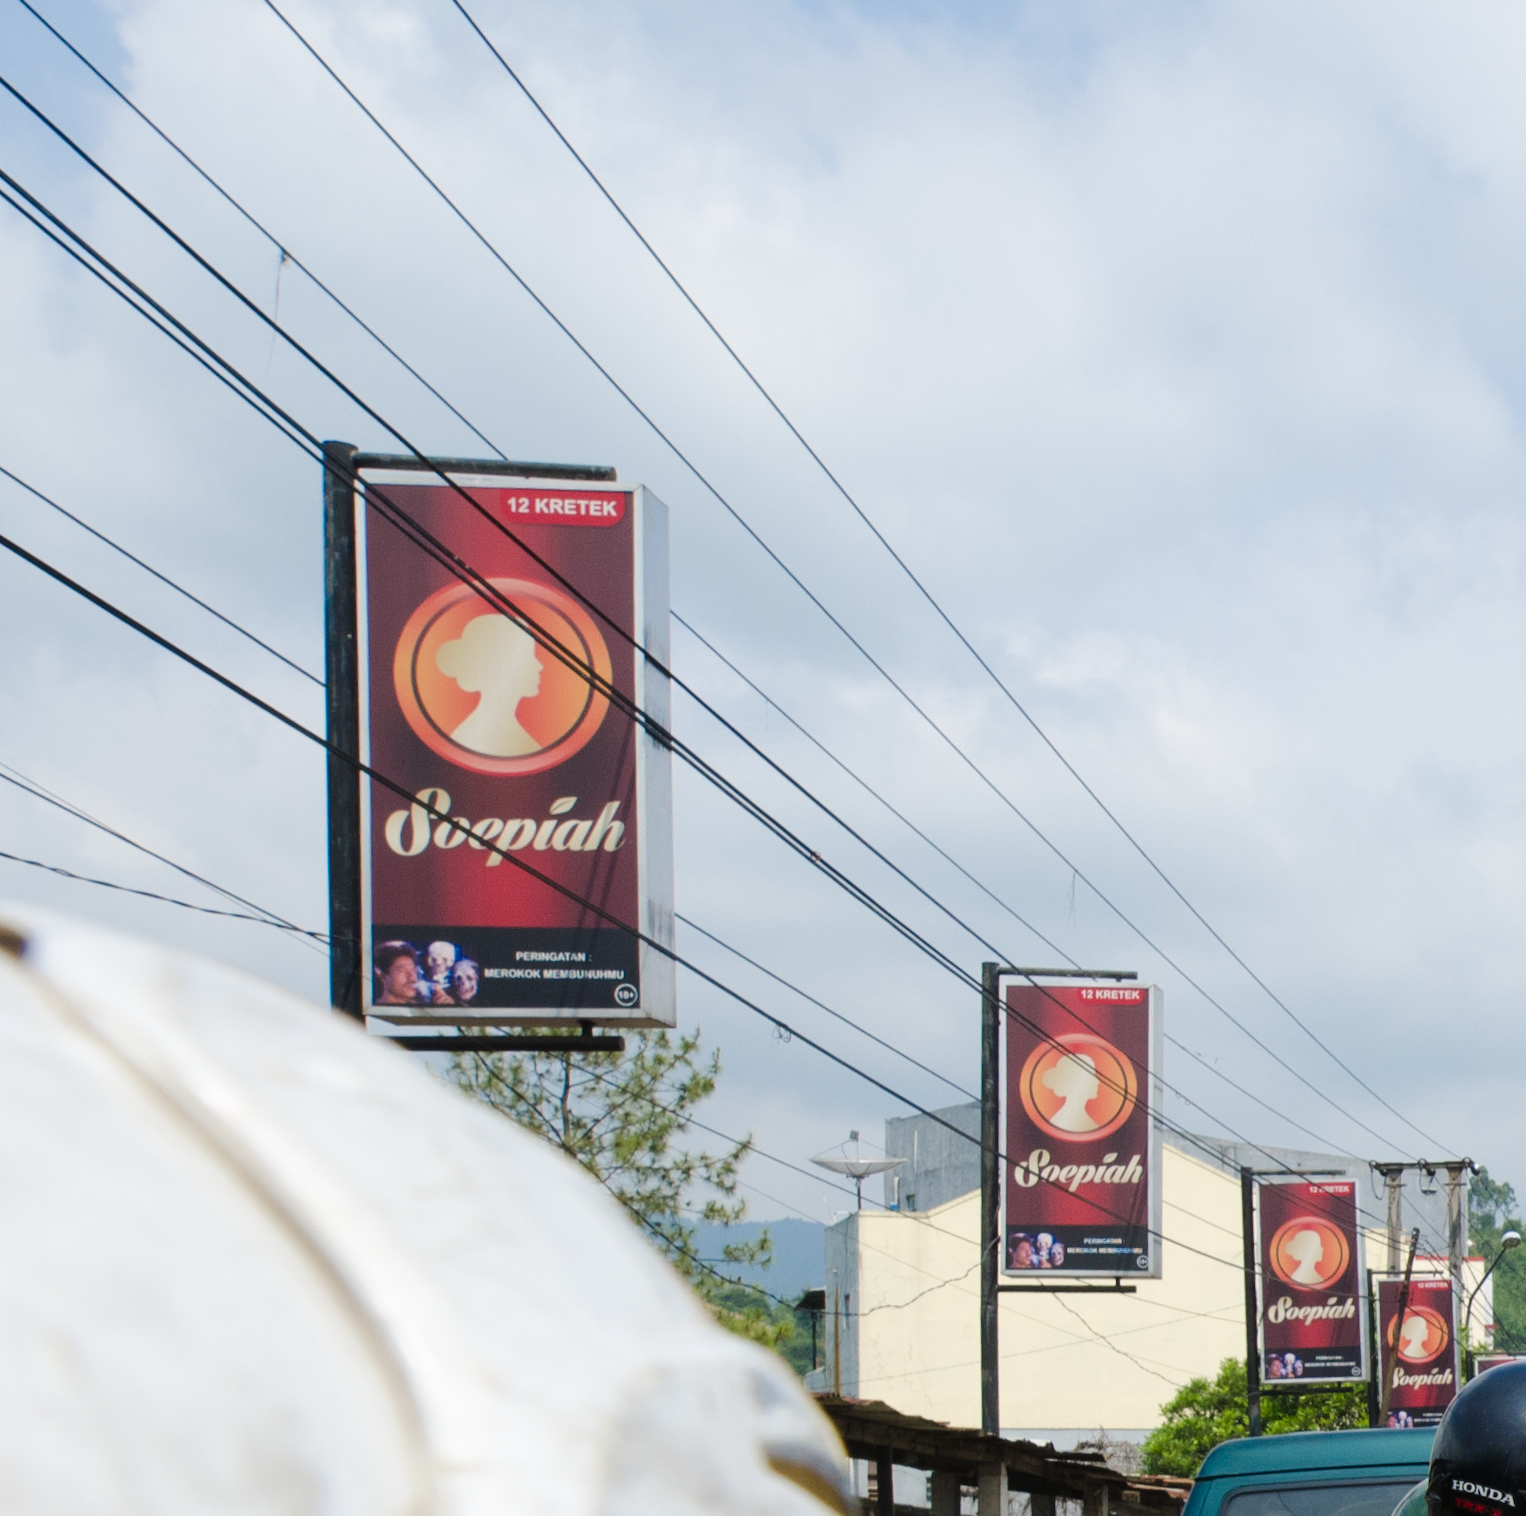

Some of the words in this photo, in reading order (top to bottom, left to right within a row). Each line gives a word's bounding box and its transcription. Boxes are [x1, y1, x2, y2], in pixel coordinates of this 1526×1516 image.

[507, 497, 530, 513] 12
[535, 498, 617, 516] KRETEK
[385, 787, 627, 867] Soepiah
[515, 951, 586, 962] PERINGATAN
[484, 968, 541, 979] MEROKOK
[543, 969, 625, 980] MEMBUNUHMU
[1081, 989, 1094, 999] 12
[1096, 989, 1140, 1000] KRETEK
[1014, 1149, 1144, 1192] Soepiah
[1268, 1296, 1355, 1326] Soepiah
[1452, 1479, 1516, 1508] HONDA
